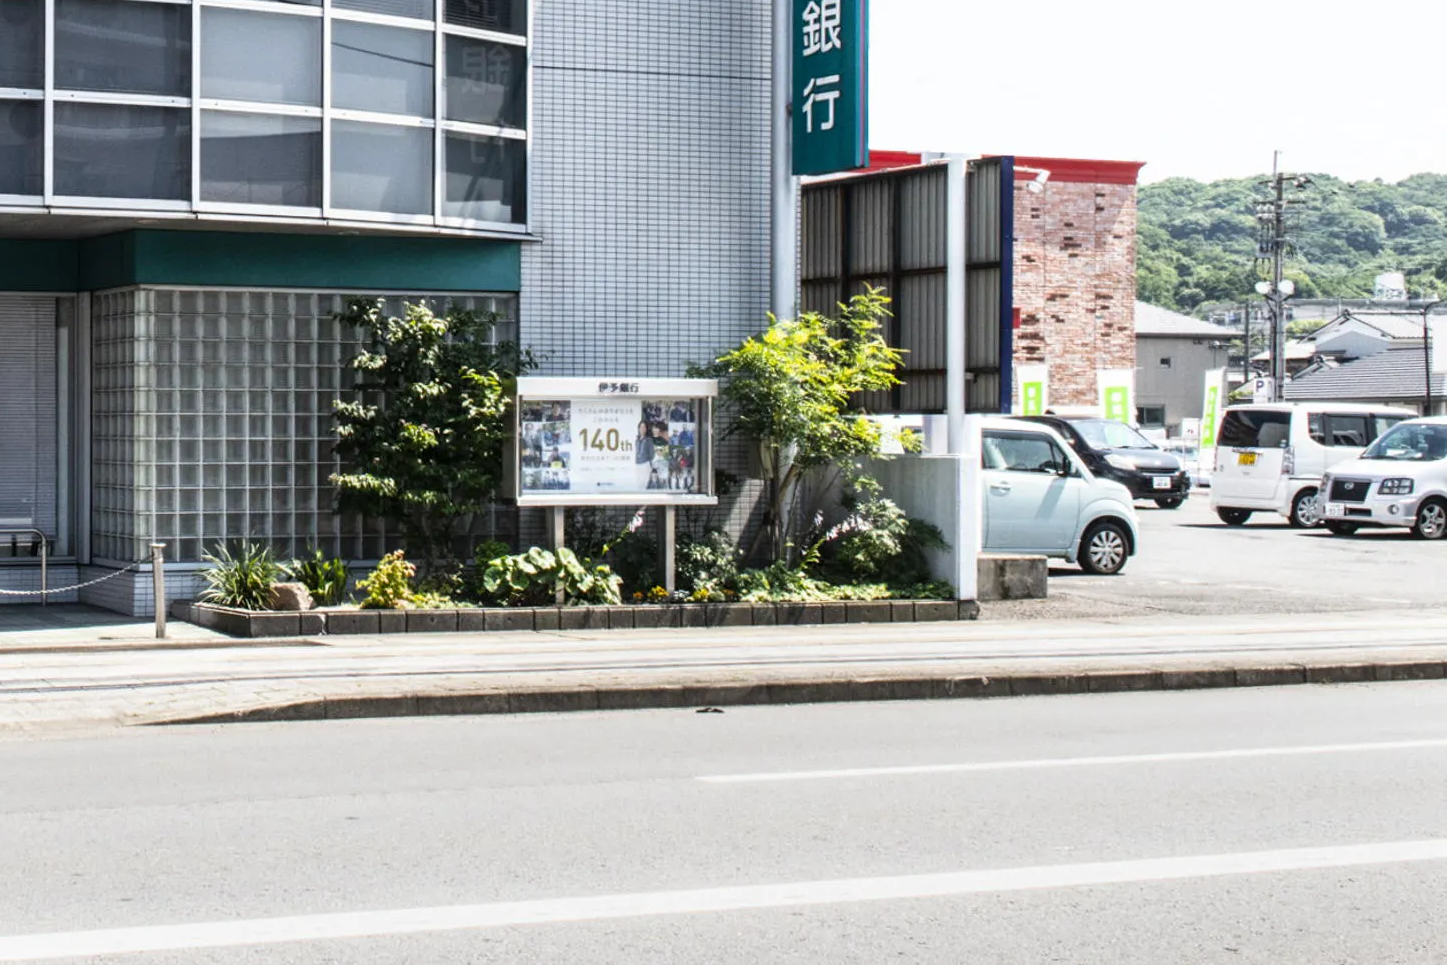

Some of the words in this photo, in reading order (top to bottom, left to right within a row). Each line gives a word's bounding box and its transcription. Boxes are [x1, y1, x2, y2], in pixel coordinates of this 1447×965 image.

[599, 382, 639, 393] 伊予銀行
[1256, 380, 1264, 392] P
[579, 428, 633, 452] 140th
